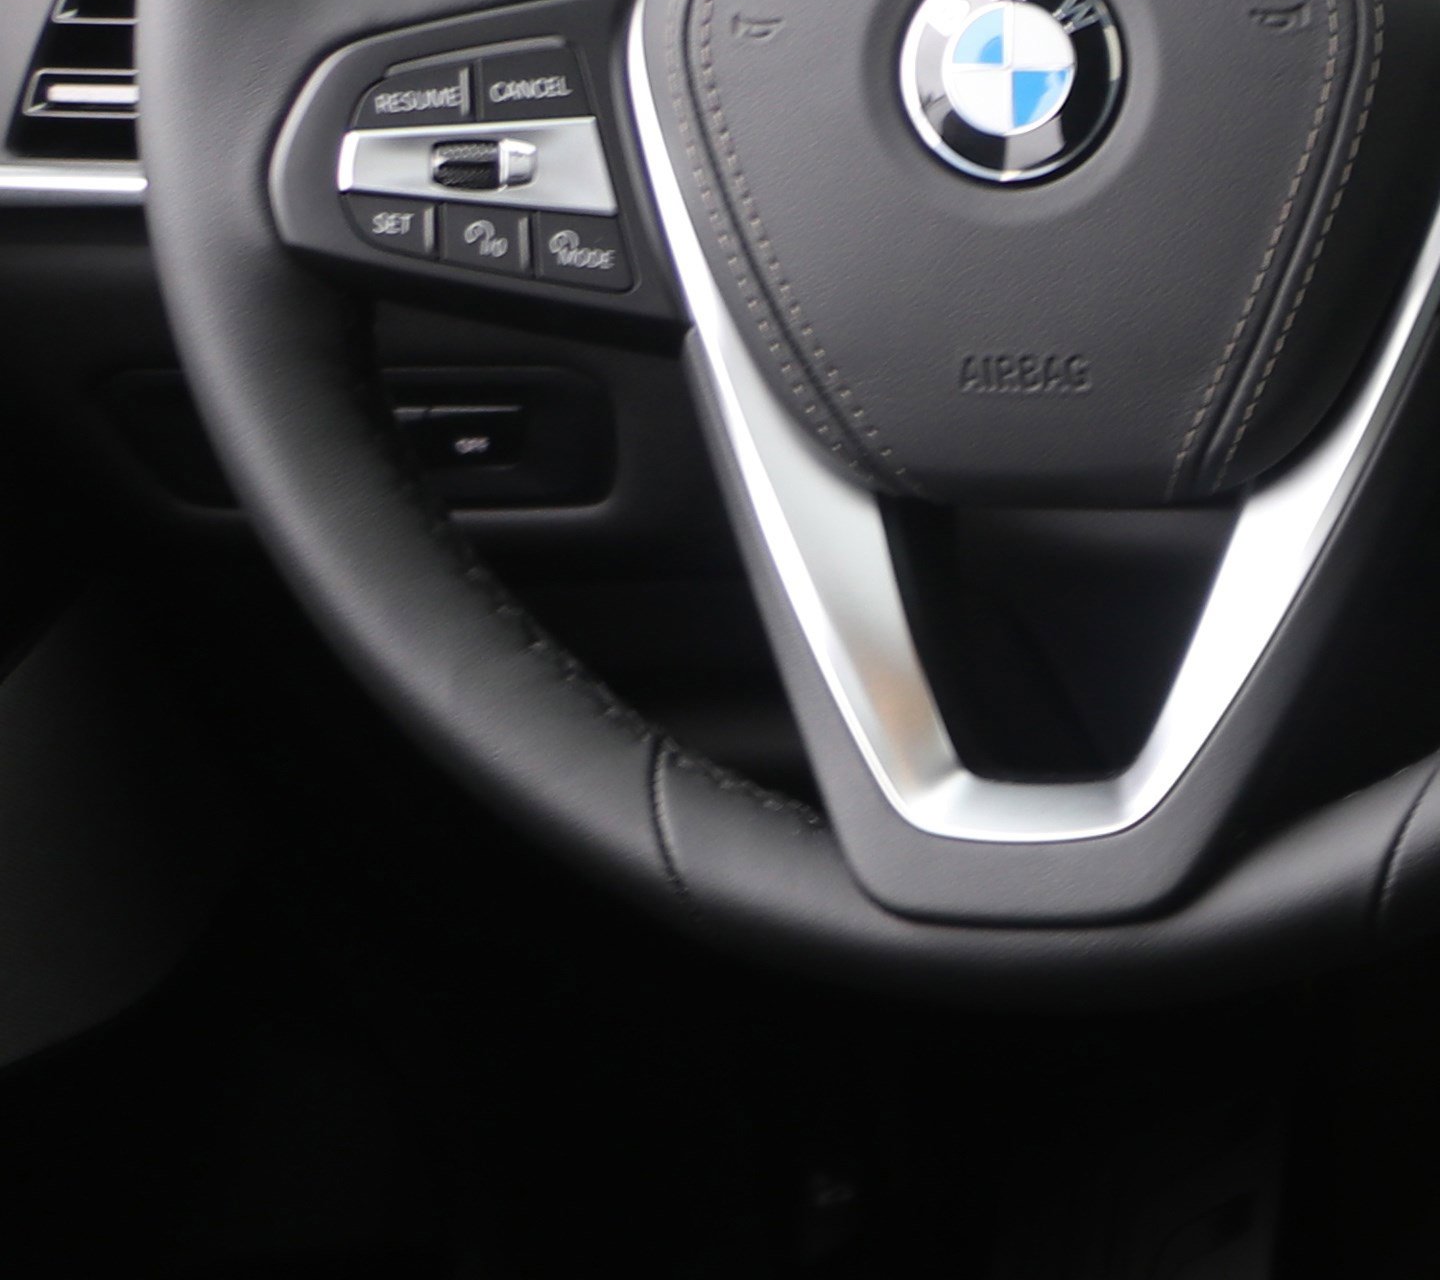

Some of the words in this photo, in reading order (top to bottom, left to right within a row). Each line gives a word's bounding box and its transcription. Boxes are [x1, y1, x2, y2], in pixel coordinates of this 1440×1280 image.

[374, 83, 462, 114] RESUME
[489, 75, 573, 104] CANCEL
[371, 212, 416, 237] SET
[556, 247, 617, 271] MODE
[959, 354, 1093, 393] AIRBAG
